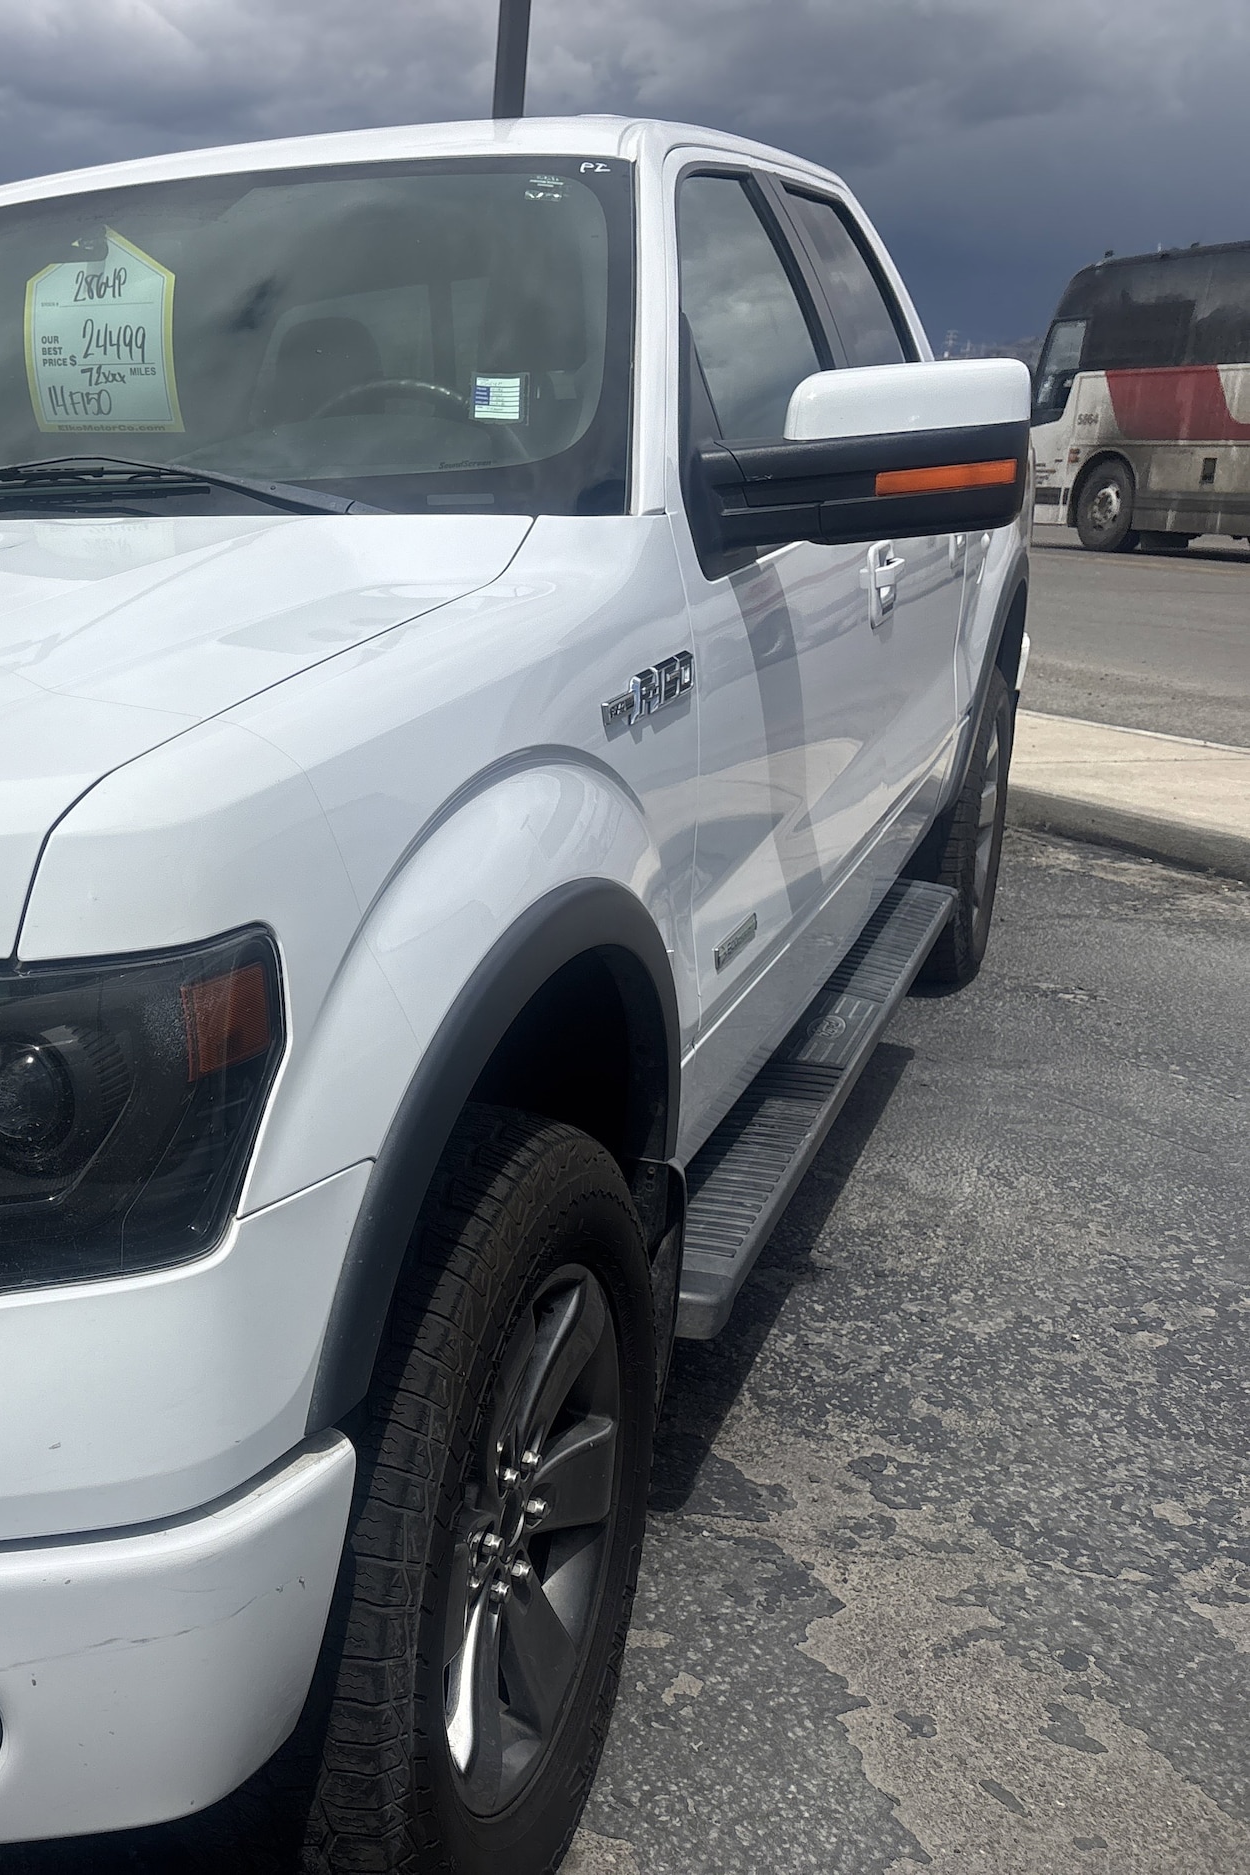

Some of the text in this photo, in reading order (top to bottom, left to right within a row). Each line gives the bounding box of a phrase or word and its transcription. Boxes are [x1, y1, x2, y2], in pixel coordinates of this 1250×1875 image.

[73, 266, 127, 302] 2864P
[41, 335, 60, 345] OUR
[82, 318, 146, 364] 24499
[41, 346, 63, 356] BEST
[42, 357, 68, 367] PRICE
[130, 366, 156, 376] MILES
[58, 424, 166, 432] ElkoMotorCo.com
